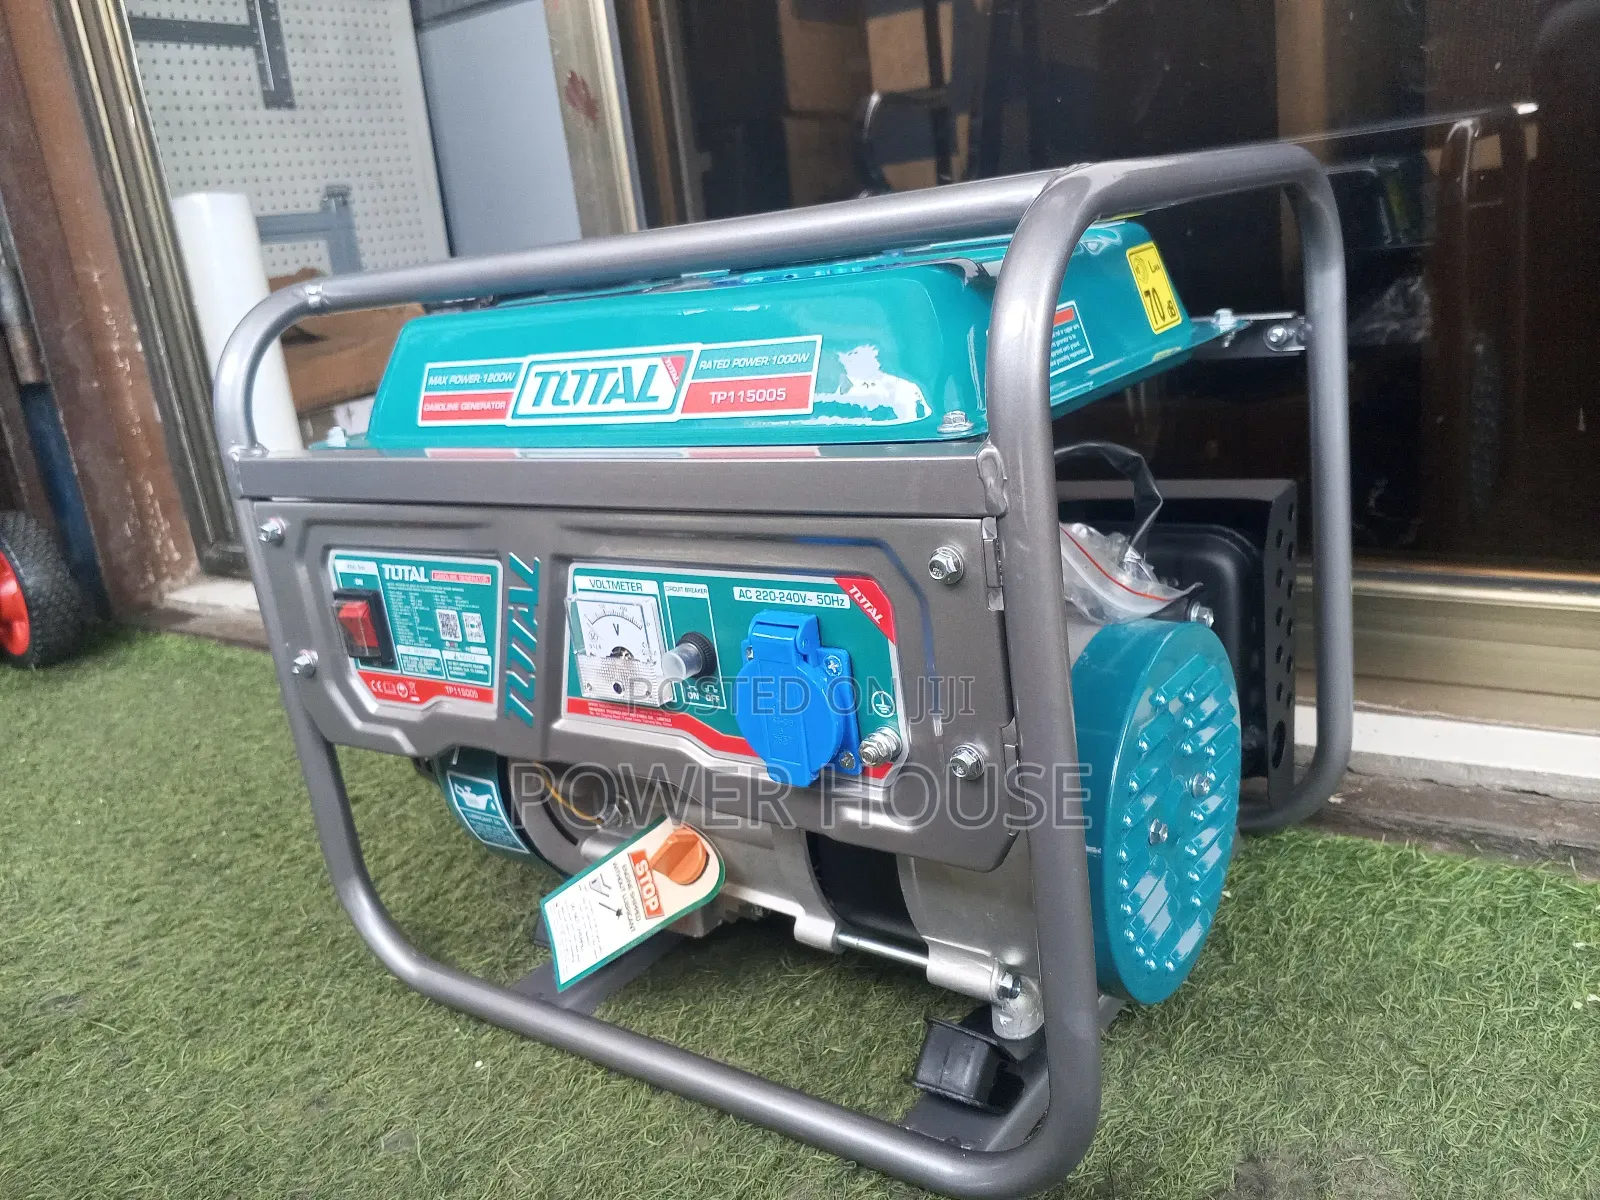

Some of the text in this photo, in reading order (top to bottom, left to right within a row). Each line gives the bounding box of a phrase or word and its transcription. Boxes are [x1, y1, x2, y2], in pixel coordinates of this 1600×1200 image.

[1144, 287, 1166, 326] 70
[699, 353, 810, 371] RATED POWER:1000W
[428, 375, 449, 386] MAX
[531, 363, 661, 409] TOTAL
[709, 387, 787, 404] TP115005
[460, 400, 507, 411] GENERATOR
[382, 564, 430, 582] TOTAL
[589, 579, 643, 592] VOLTMETER
[665, 585, 708, 594] CIRCUIT BREAKER
[738, 588, 753, 600] AC
[816, 594, 846, 607] 50Hz
[848, 583, 884, 625] TOTAL
[504, 551, 541, 728] TOTAL
[687, 691, 720, 703] ON OFF
[635, 858, 661, 913] STOP
